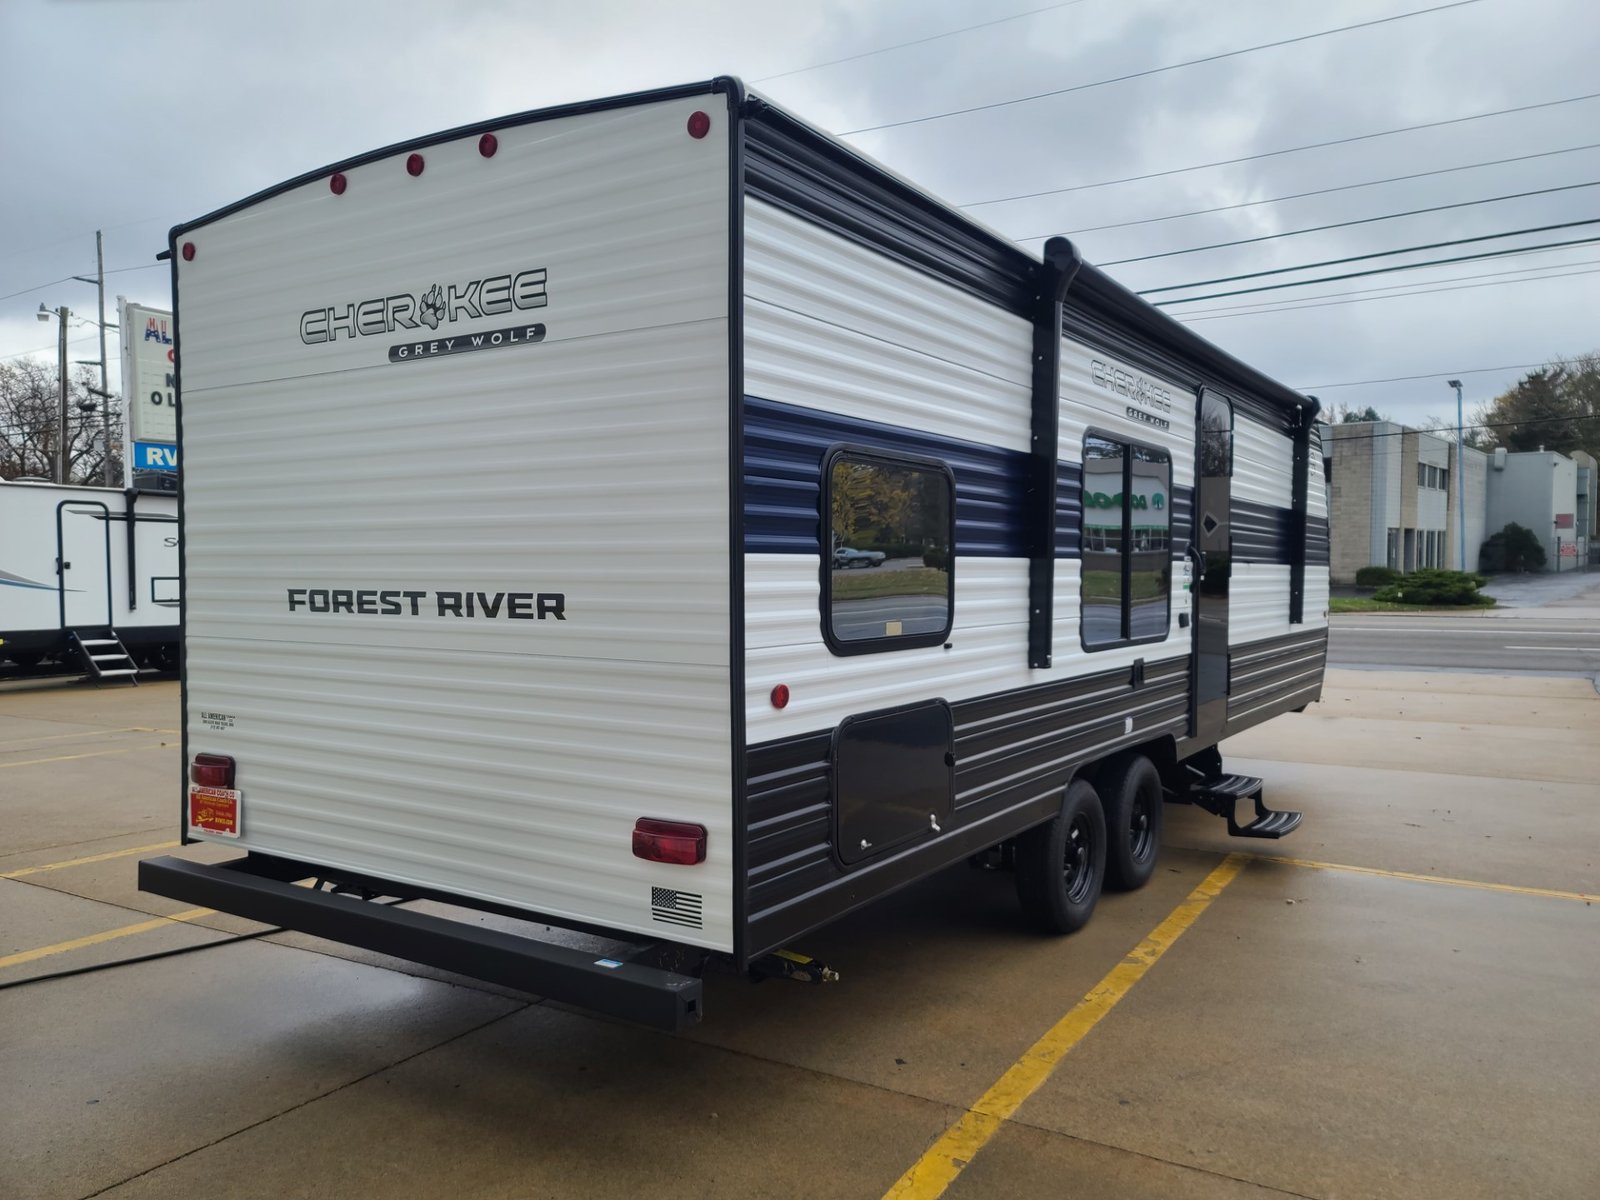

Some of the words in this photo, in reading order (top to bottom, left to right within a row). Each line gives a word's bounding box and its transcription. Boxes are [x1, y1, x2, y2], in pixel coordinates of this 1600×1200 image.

[398, 339, 455, 358] GREY
[471, 327, 537, 347] WOLF
[1128, 408, 1148, 422] GREY
[1149, 417, 1169, 429] WOLF
[146, 447, 177, 466] RV
[164, 537, 179, 548] S
[286, 588, 427, 616] FOREST
[435, 591, 567, 621] RIVER
